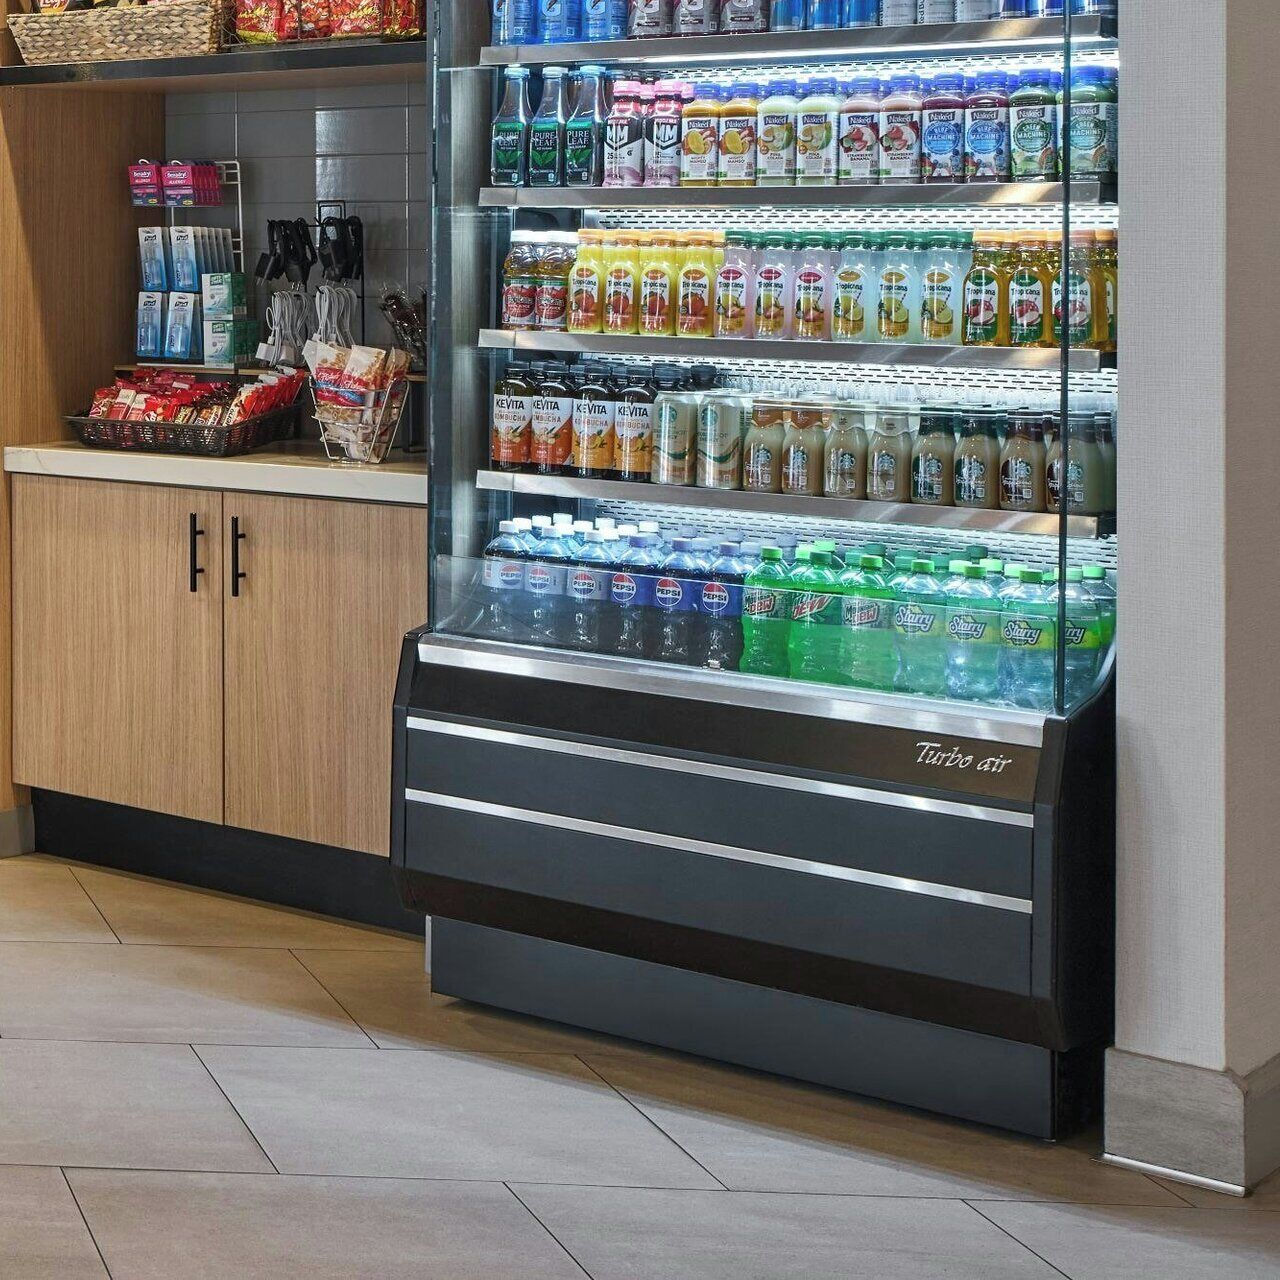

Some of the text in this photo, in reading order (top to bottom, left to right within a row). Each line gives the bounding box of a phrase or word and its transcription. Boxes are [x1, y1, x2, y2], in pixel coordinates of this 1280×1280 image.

[931, 111, 953, 120] Naked
[973, 111, 996, 120] Naked
[1019, 109, 1043, 118] Naked
[689, 120, 710, 128] Naked
[727, 120, 748, 128] Naked
[765, 115, 786, 124] Naked
[803, 115, 825, 124] Naked
[850, 116, 872, 125] Naked
[889, 115, 912, 124] Naked
[535, 131, 555, 140] PURE
[567, 130, 590, 138] PURE
[927, 132, 955, 140] MACHINE
[971, 132, 999, 140] MACHINE
[1017, 130, 1048, 138] MACHINE
[1070, 128, 1102, 136] MACHINE
[534, 139, 555, 147] LEAF
[568, 137, 589, 146] LEAF
[835, 282, 864, 291] Tropicana
[879, 283, 908, 292] Tropicana
[923, 283, 952, 292] Tropicana
[496, 398, 525, 410] KEVITA
[576, 403, 607, 415] KEVITA
[617, 405, 649, 418] KEVITA
[529, 575, 550, 583] PEPSI
[573, 580, 595, 588] PEPSI
[613, 583, 636, 592] PEPSI
[656, 588, 681, 597] PEPSI
[703, 592, 727, 601] PEPSI
[895, 606, 934, 630] Starry
[949, 615, 986, 639] Starry
[1003, 621, 1040, 645] Starry
[1064, 624, 1085, 644] rry
[916, 741, 1013, 773] Turbo air
